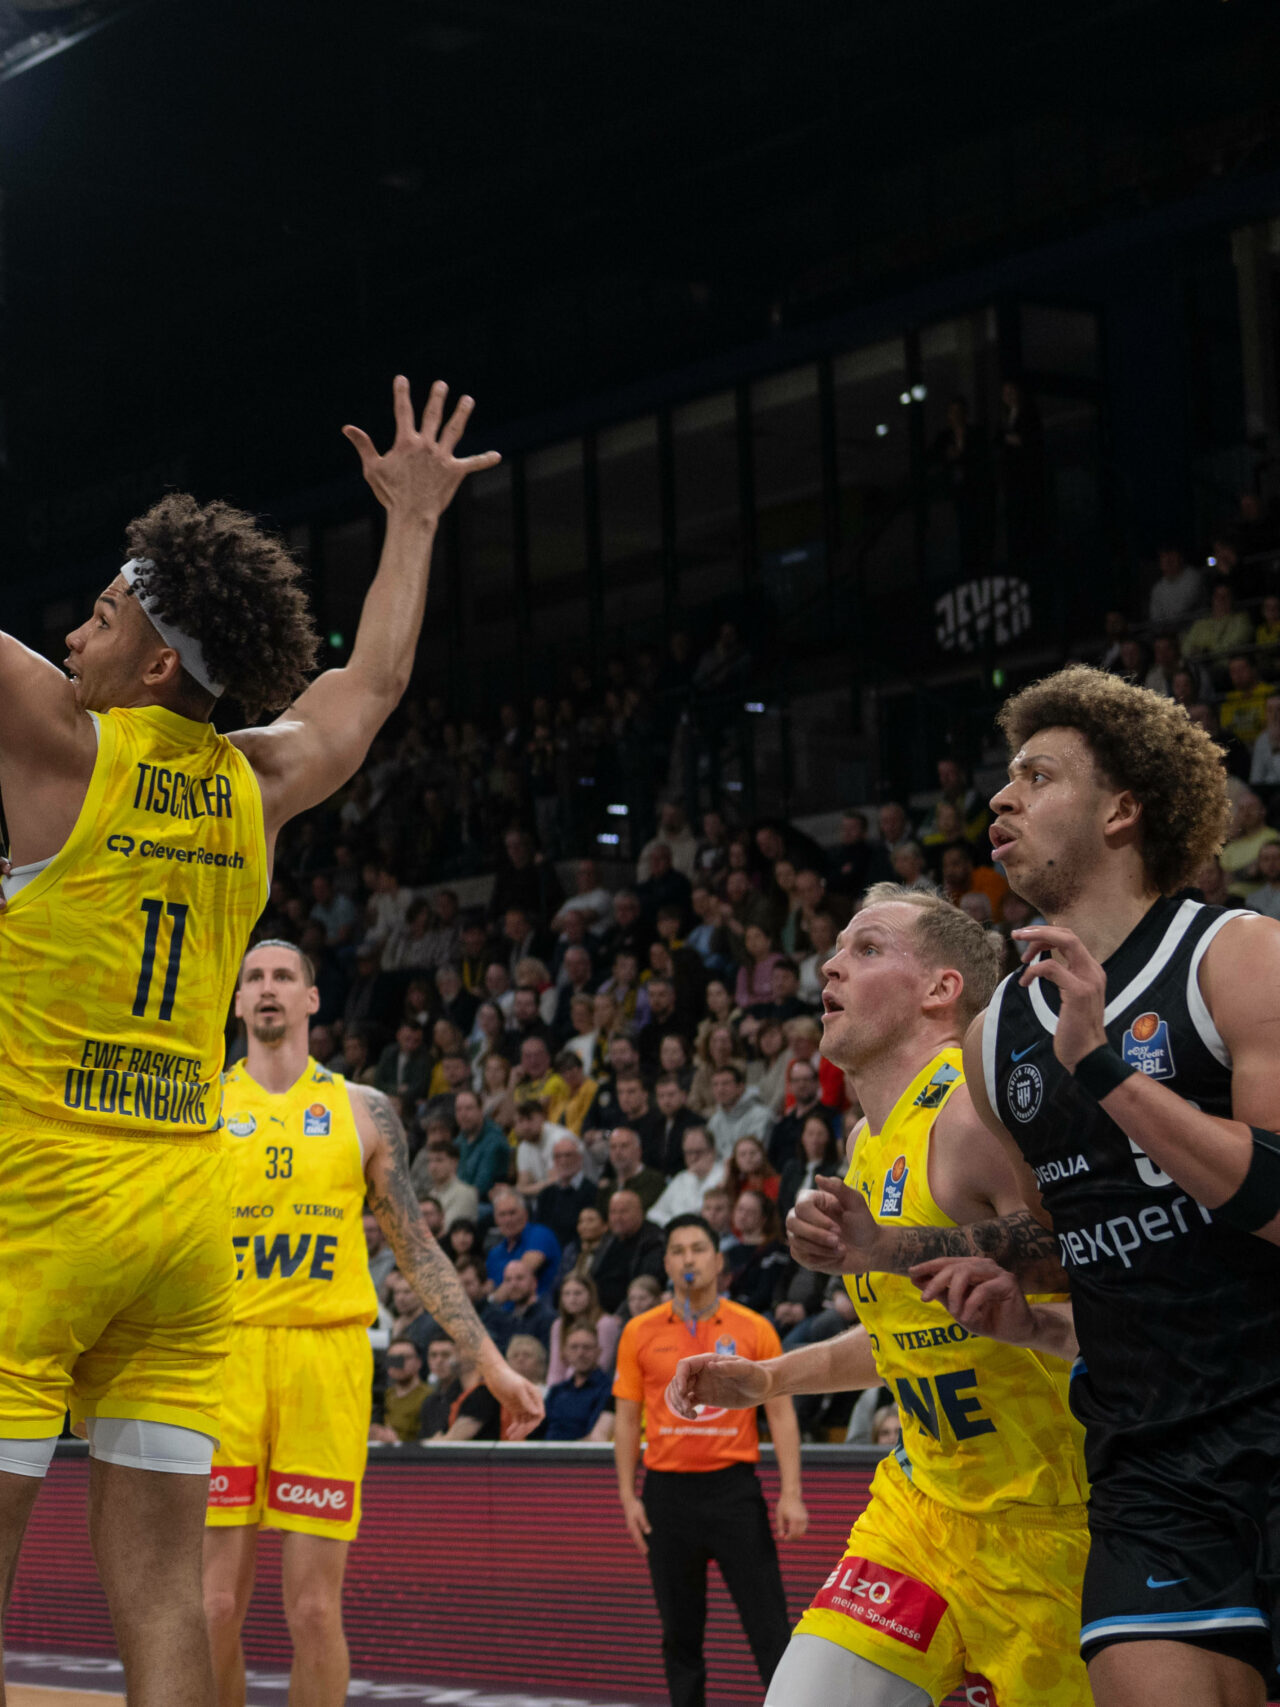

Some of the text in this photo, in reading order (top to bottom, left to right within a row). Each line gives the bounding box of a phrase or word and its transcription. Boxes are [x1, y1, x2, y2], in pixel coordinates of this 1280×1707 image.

[133, 762, 232, 820] TISCHLER
[140, 840, 244, 869] CleverReach
[132, 898, 189, 1021] 11
[81, 1040, 201, 1083] EWE BASKETS
[65, 1068, 210, 1125] OLDENBURG
[265, 1146, 294, 1180] 33
[1032, 1154, 1090, 1184] VEOLIA
[882, 1198, 899, 1212] BBL
[1058, 1196, 1212, 1268] nexperi
[893, 1323, 980, 1351] VIERO
[276, 1483, 347, 1509] cewe
[839, 1569, 891, 1604] LzO
[832, 1595, 921, 1642] meine Sparkasse
